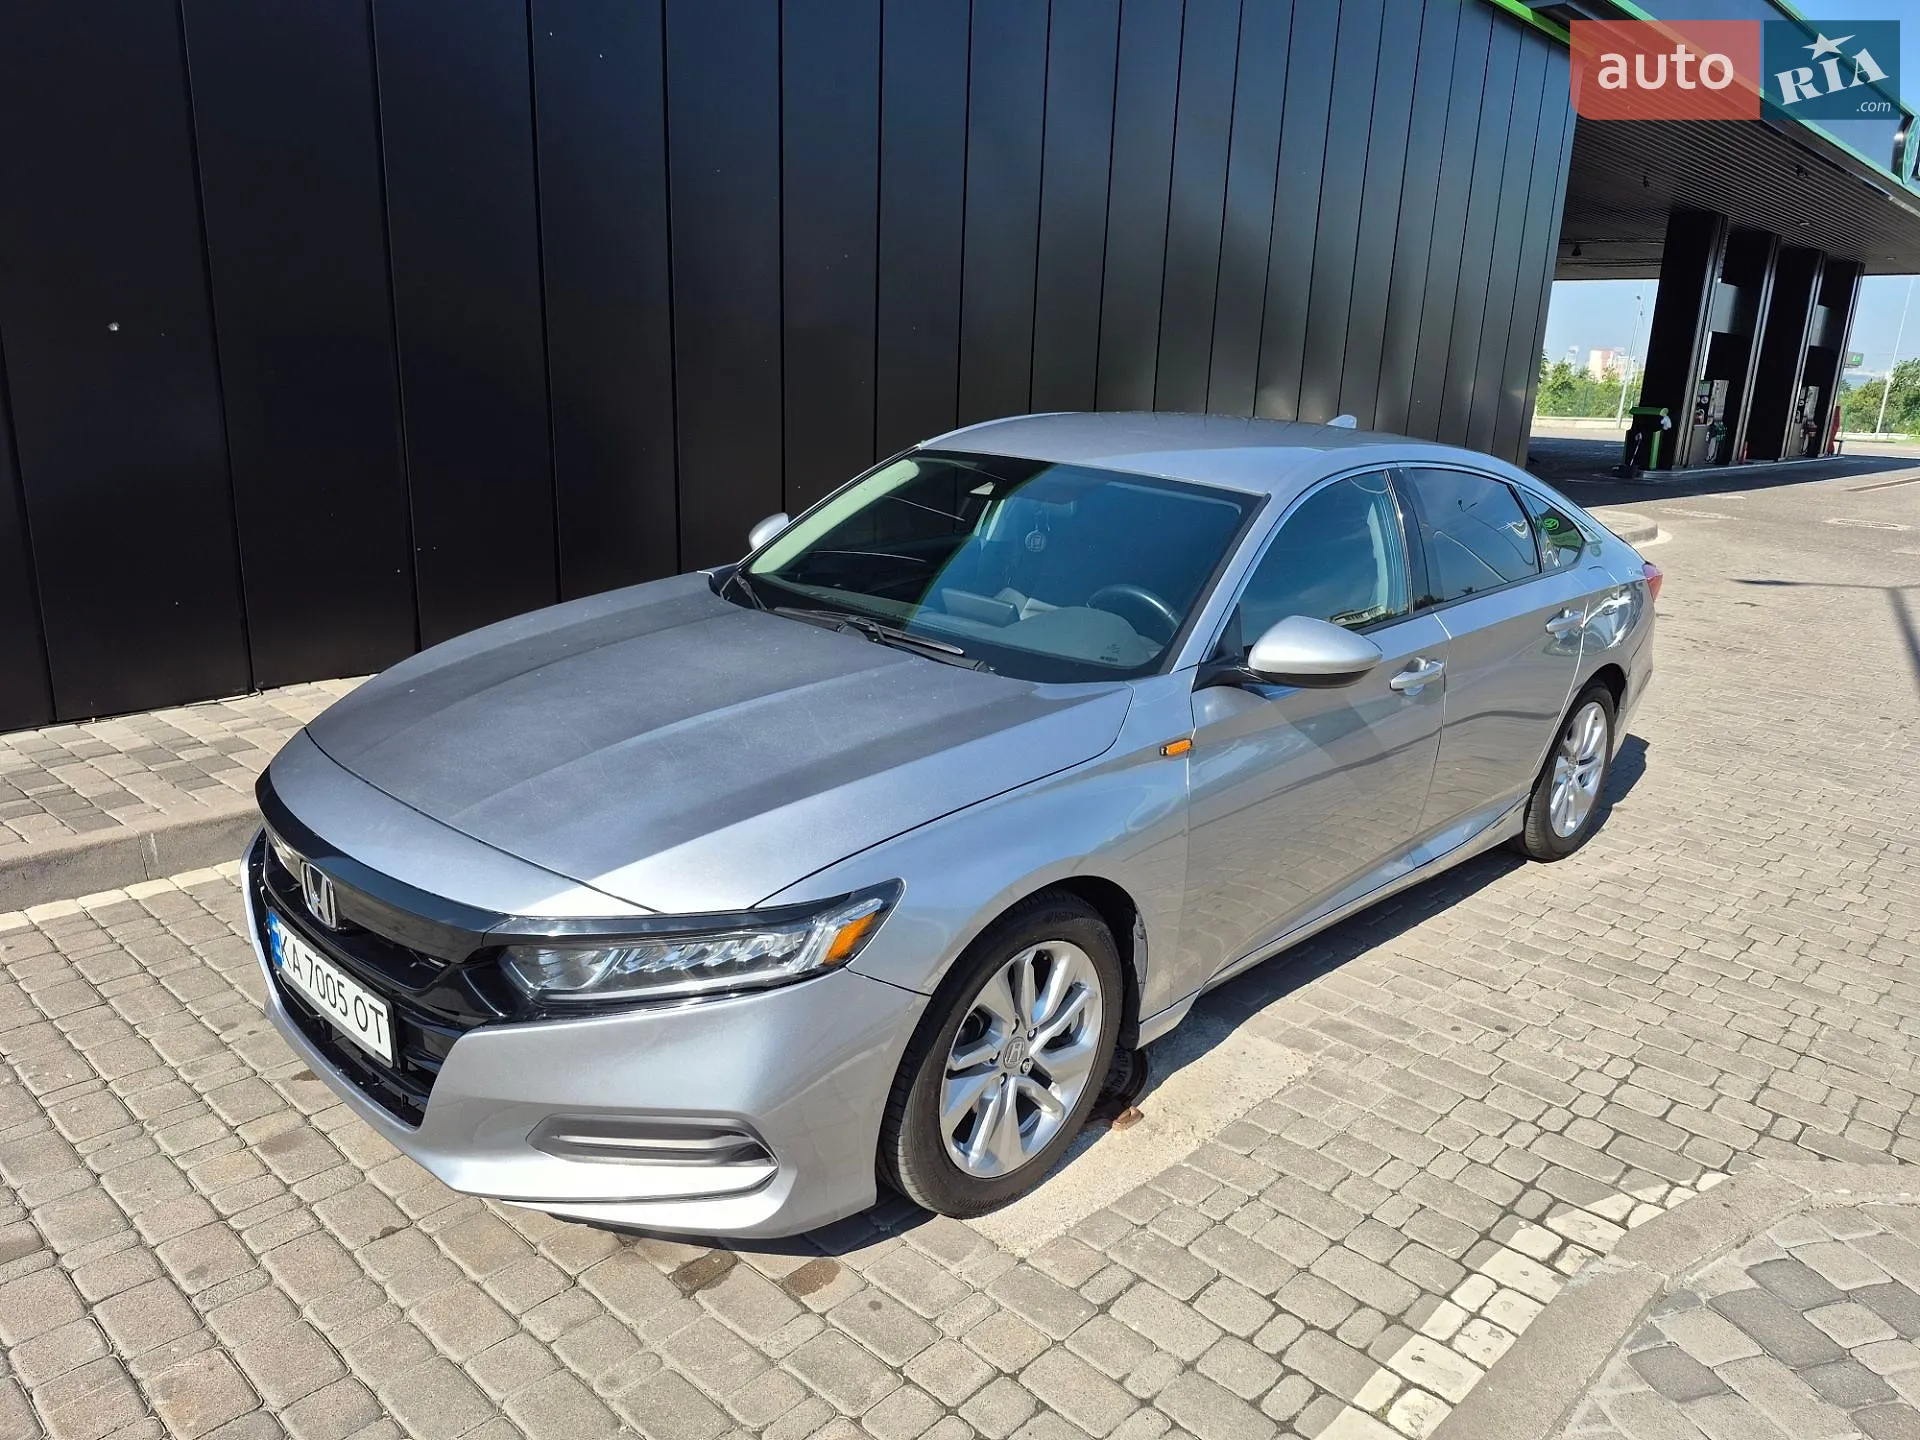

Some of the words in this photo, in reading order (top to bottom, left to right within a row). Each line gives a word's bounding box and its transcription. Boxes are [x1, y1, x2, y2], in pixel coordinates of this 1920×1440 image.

[279, 935, 303, 980] KA
[305, 953, 348, 1017] 7005
[354, 995, 384, 1044] OT
